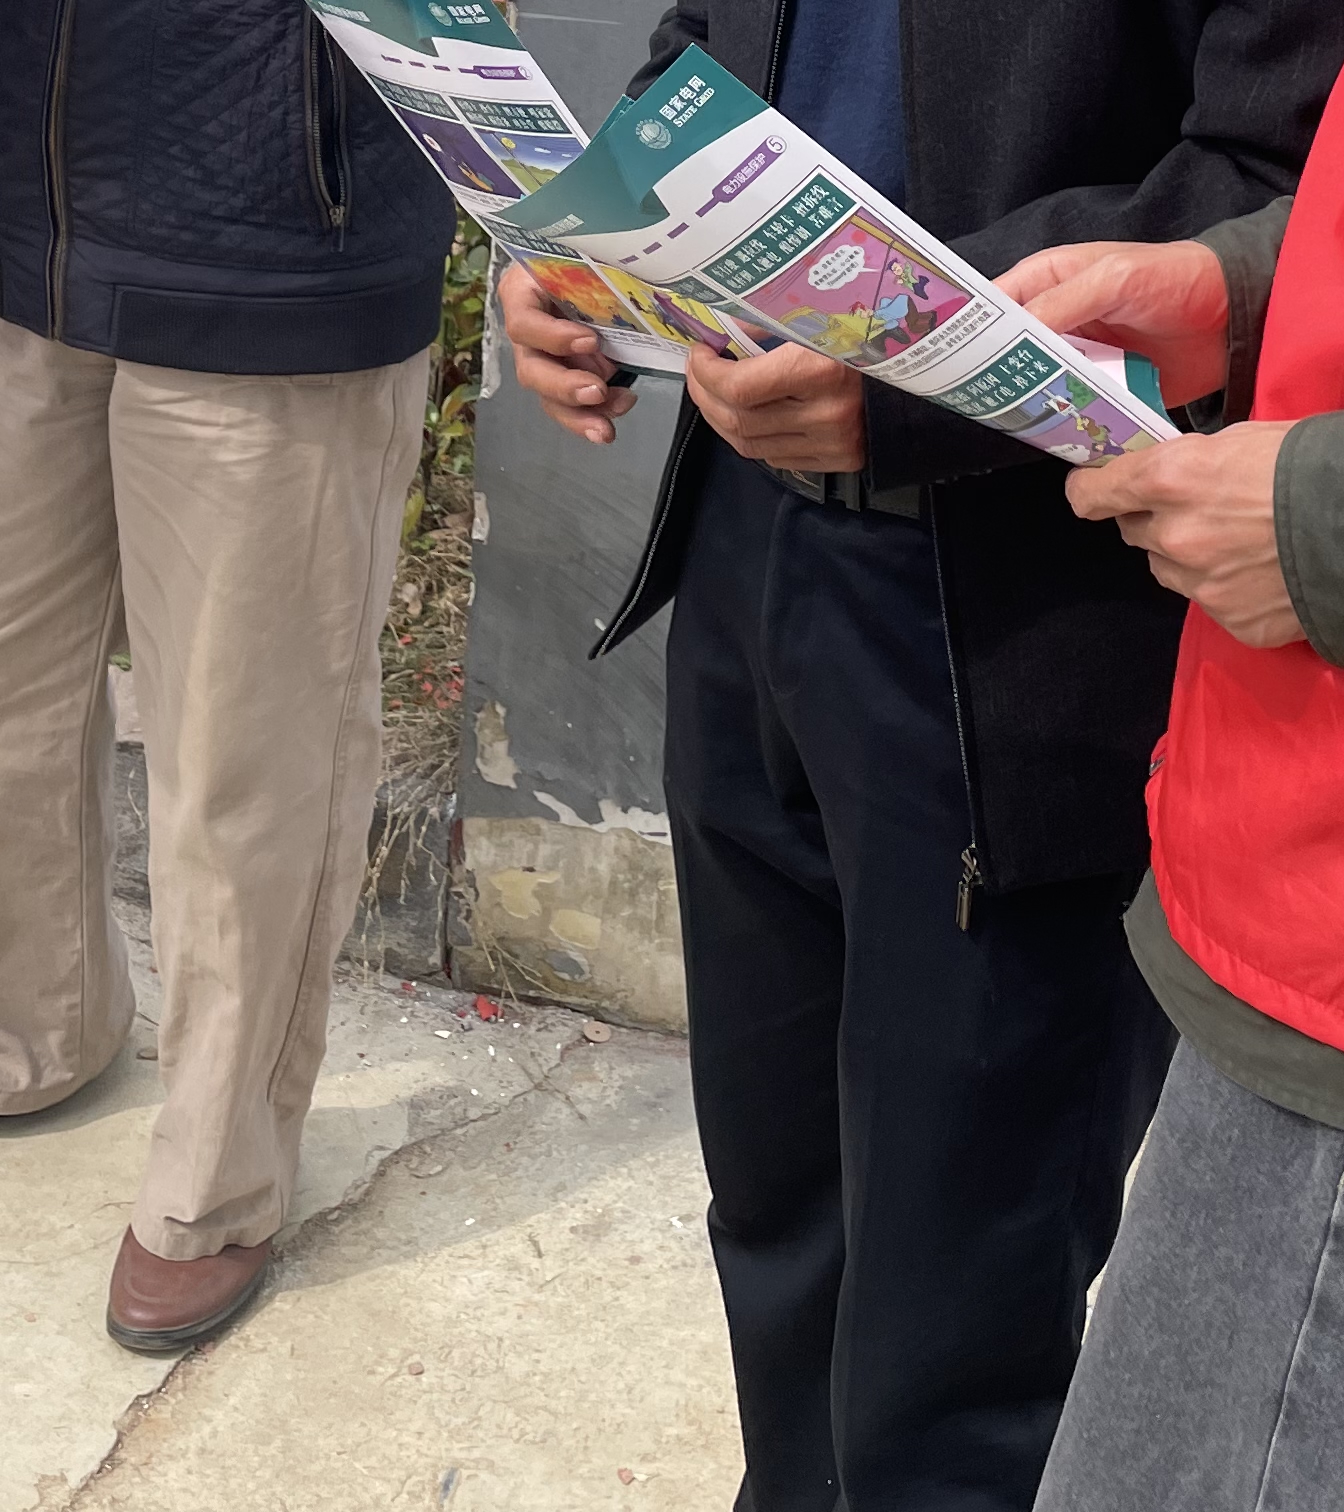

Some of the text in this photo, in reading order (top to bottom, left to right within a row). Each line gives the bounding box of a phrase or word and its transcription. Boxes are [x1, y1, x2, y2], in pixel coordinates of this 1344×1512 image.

[659, 75, 706, 120] 国家电网
[673, 87, 715, 128] STATE GRID
[722, 138, 783, 195] 电力设施保护 5
